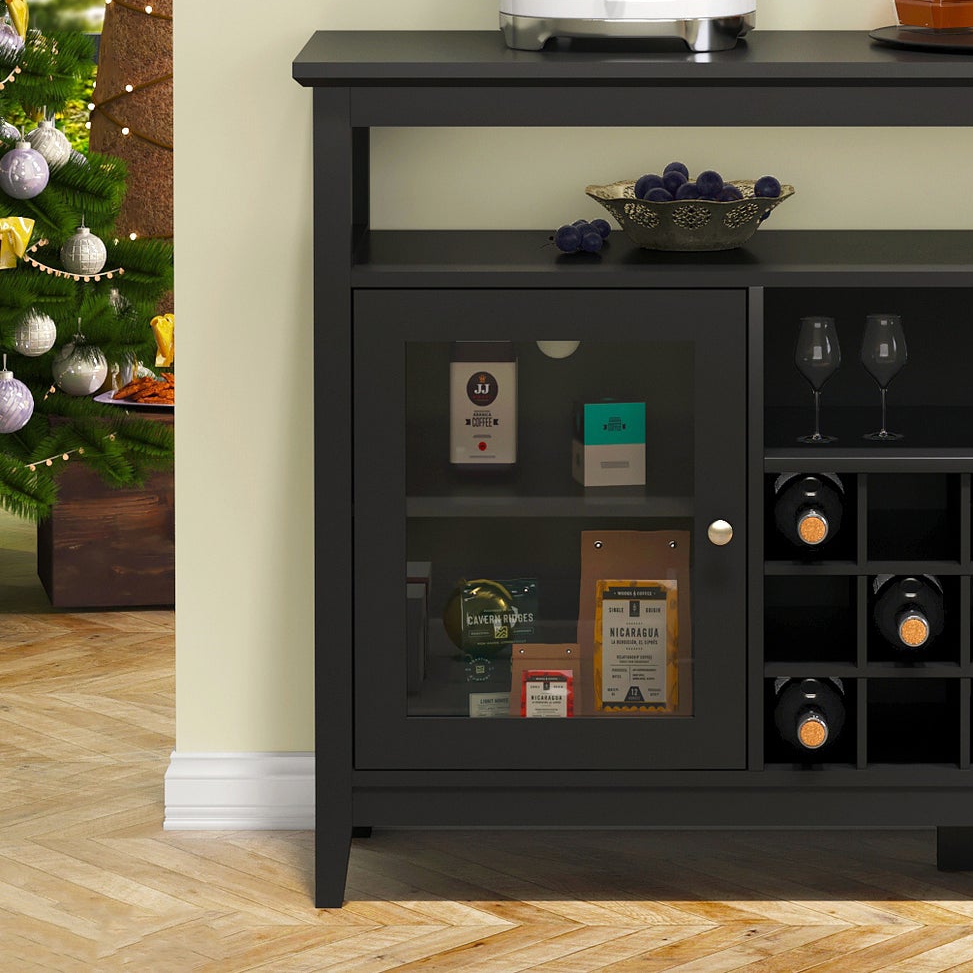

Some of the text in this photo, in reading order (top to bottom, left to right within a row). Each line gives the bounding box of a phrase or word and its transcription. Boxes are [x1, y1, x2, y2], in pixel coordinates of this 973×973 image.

[473, 383, 490, 395] JJ
[471, 417, 493, 427] COFFEE
[467, 612, 534, 626] CAVERN RIDGES
[610, 627, 659, 638] NICARAGUA
[631, 687, 638, 696] 12
